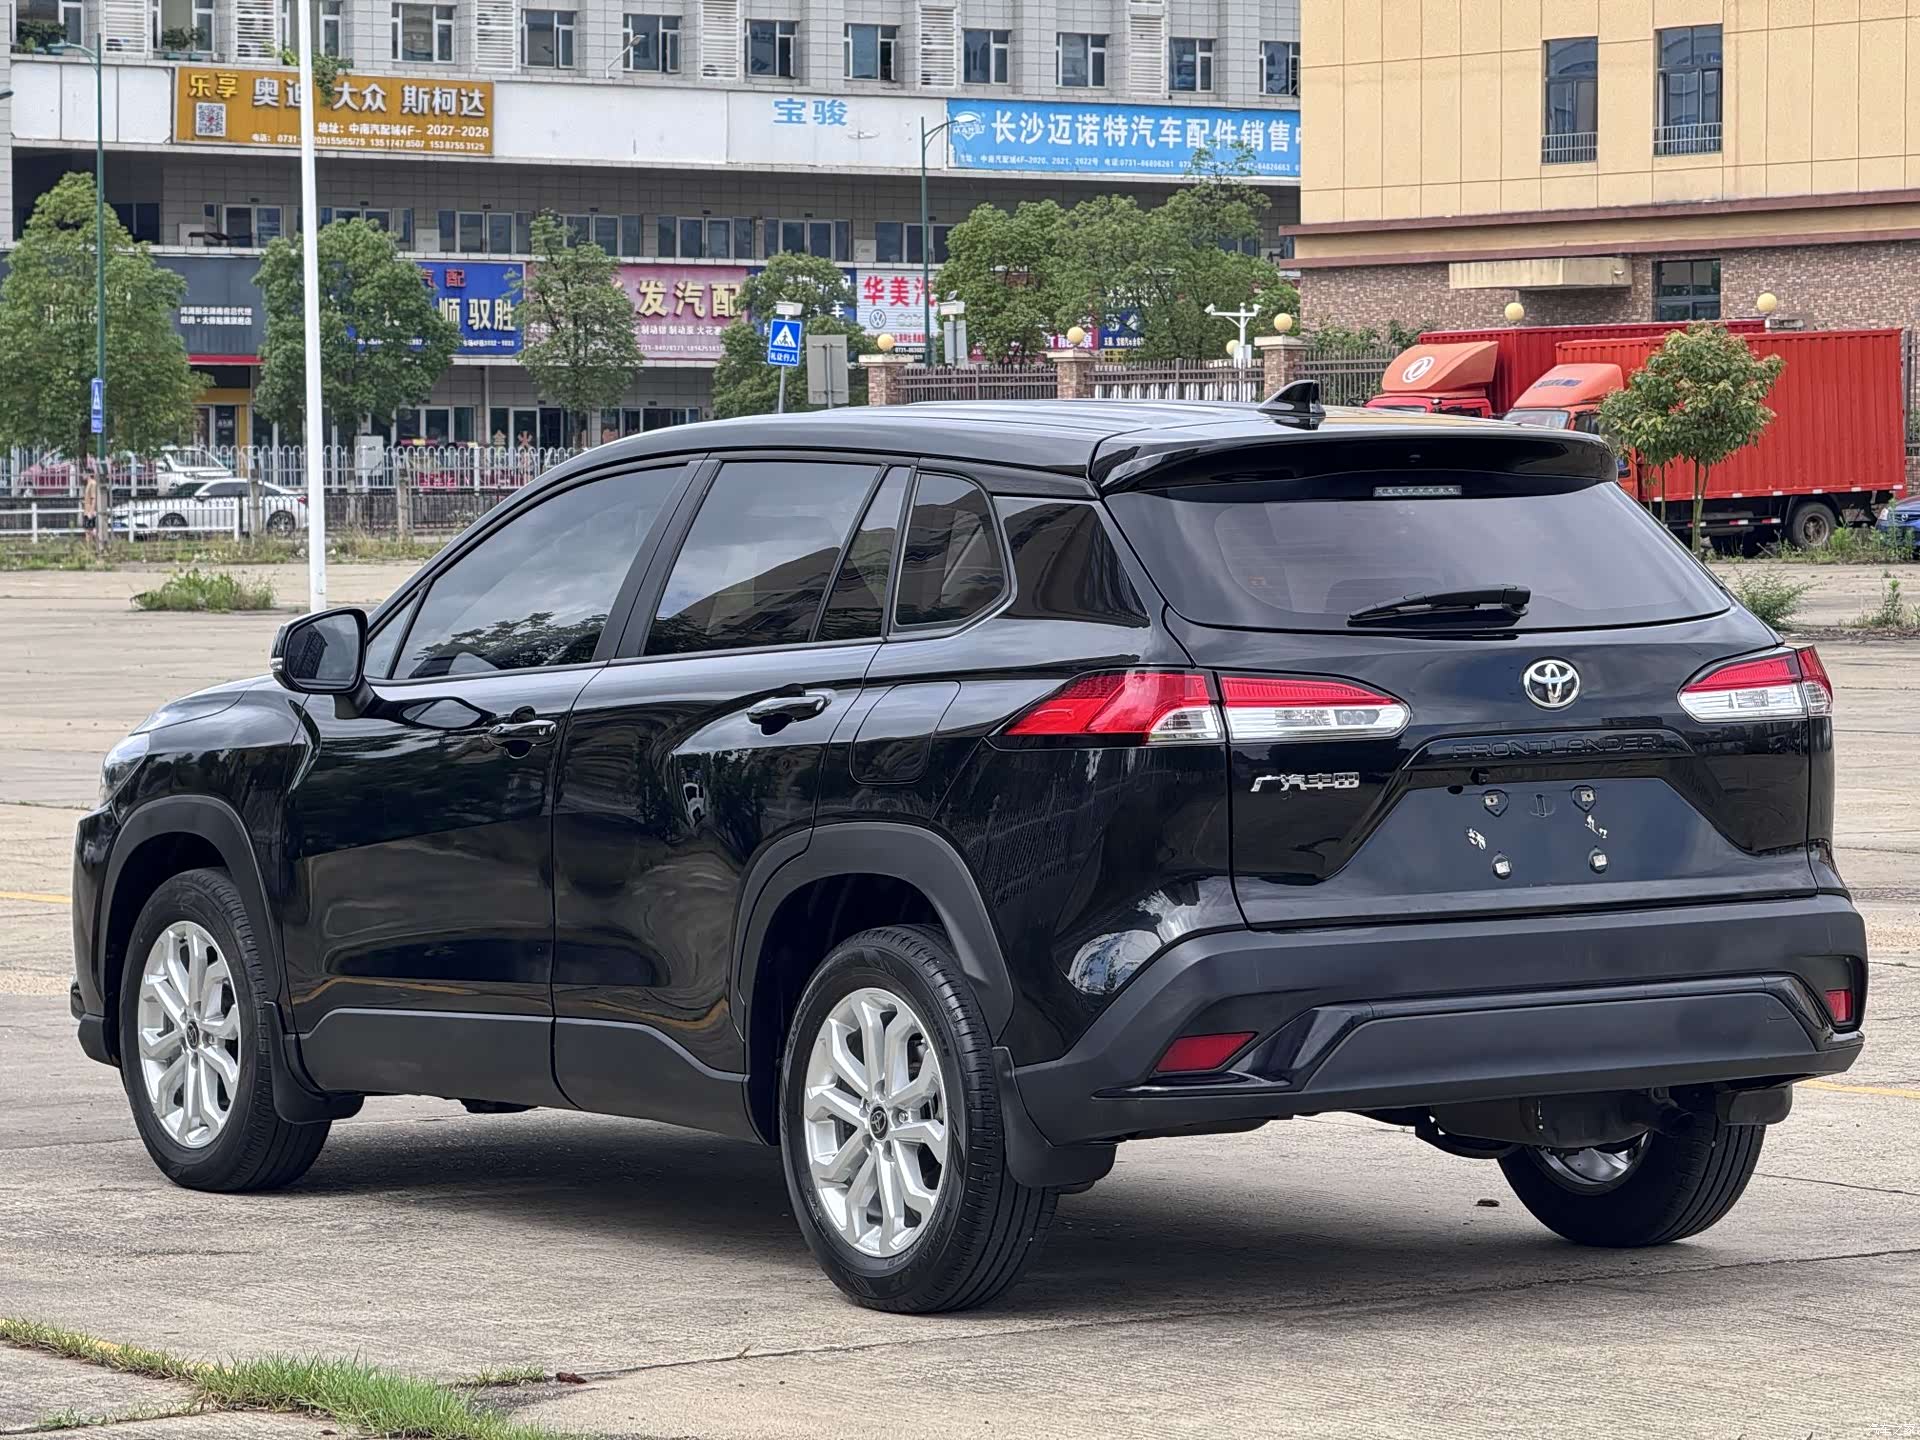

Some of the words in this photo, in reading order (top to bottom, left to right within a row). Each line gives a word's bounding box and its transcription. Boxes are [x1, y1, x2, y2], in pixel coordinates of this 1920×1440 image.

[189, 73, 239, 99] 乐享
[252, 78, 302, 108] 奥迪
[332, 82, 388, 113] 大众
[401, 85, 486, 118] 斯柯达
[773, 98, 848, 126] 宝骏
[426, 124, 490, 139] 2027-2028
[613, 279, 743, 319] 发汽配
[769, 351, 798, 363] 礼让行人
[1452, 736, 1658, 759] FRONTLANDER
[1250, 771, 1360, 792] 广汽丰田
